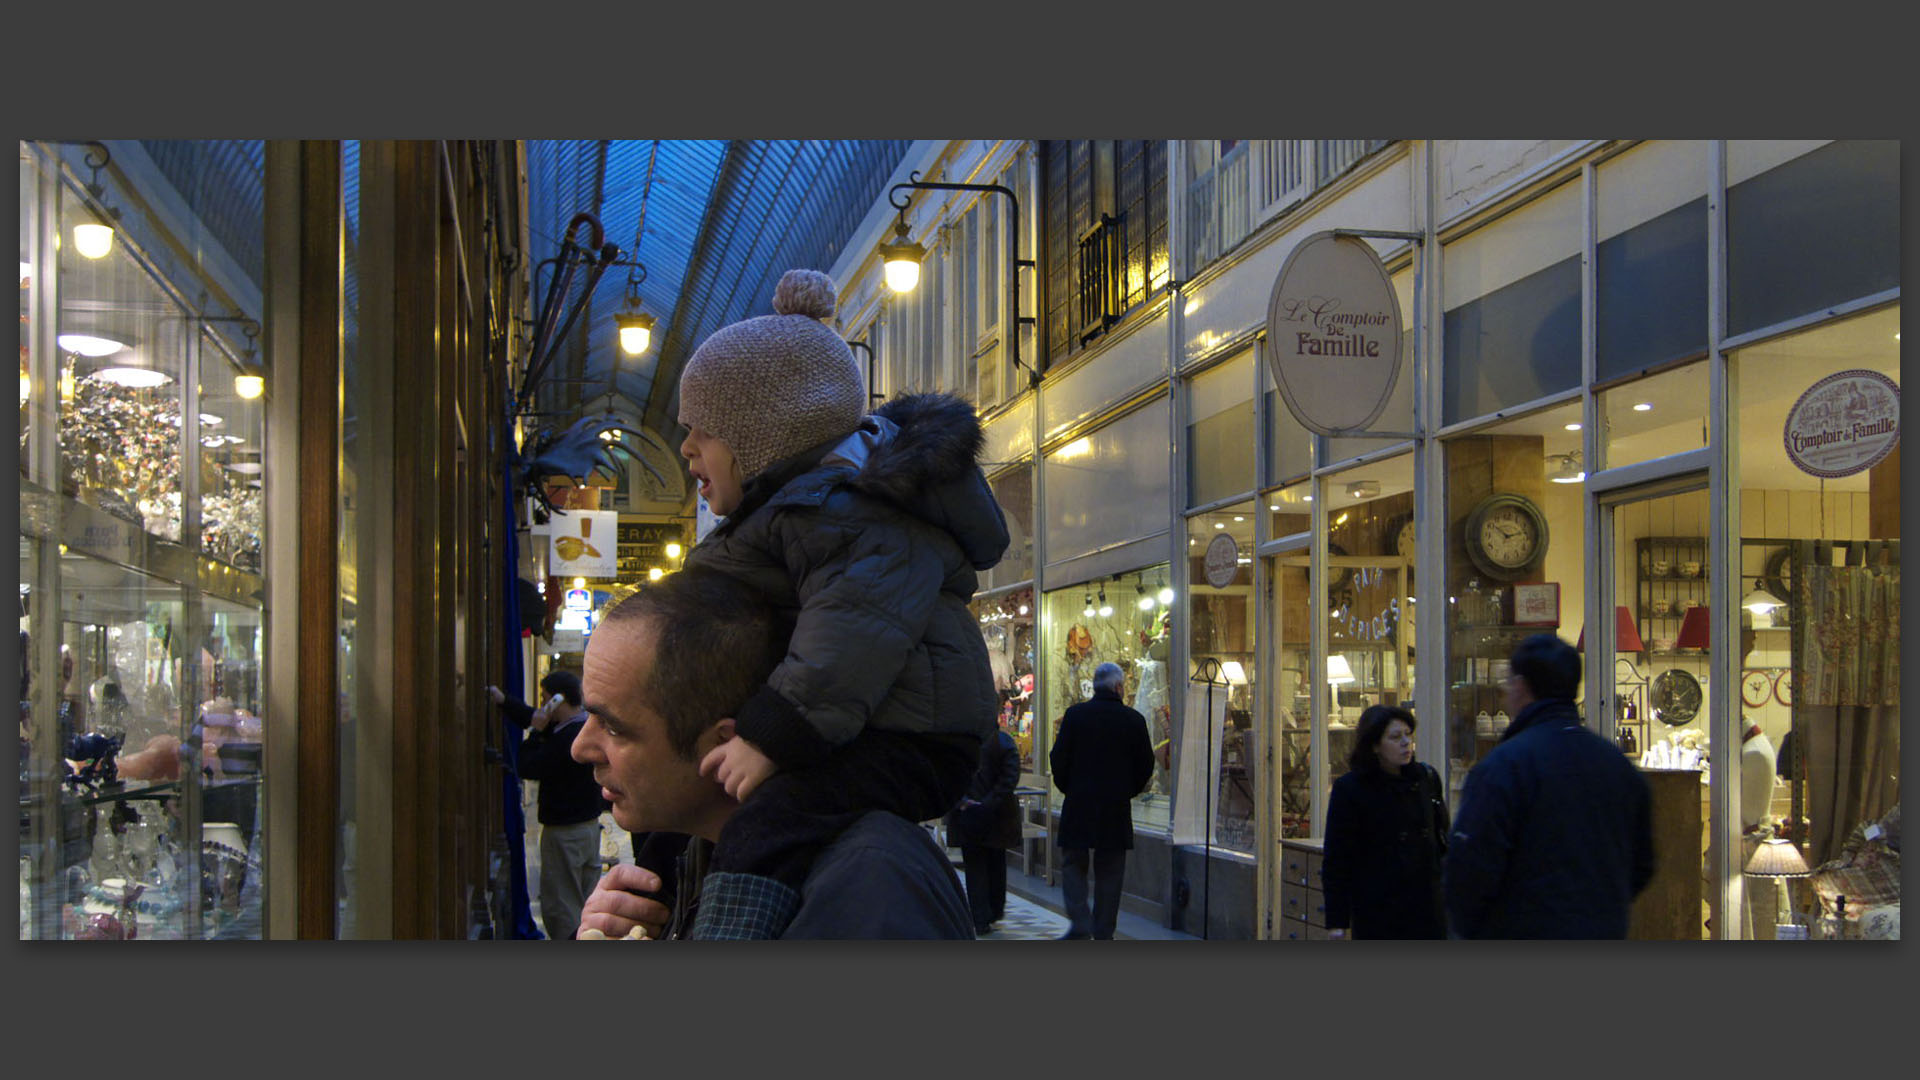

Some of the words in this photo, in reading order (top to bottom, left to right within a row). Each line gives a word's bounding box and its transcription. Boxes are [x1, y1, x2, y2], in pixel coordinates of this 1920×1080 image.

[1281, 298, 1307, 323] Le
[1307, 295, 1390, 330] Comptoir
[1296, 332, 1379, 357] Famille
[1326, 324, 1344, 336] De
[1791, 428, 1843, 453] Comptoir
[1852, 417, 1895, 442] Famille
